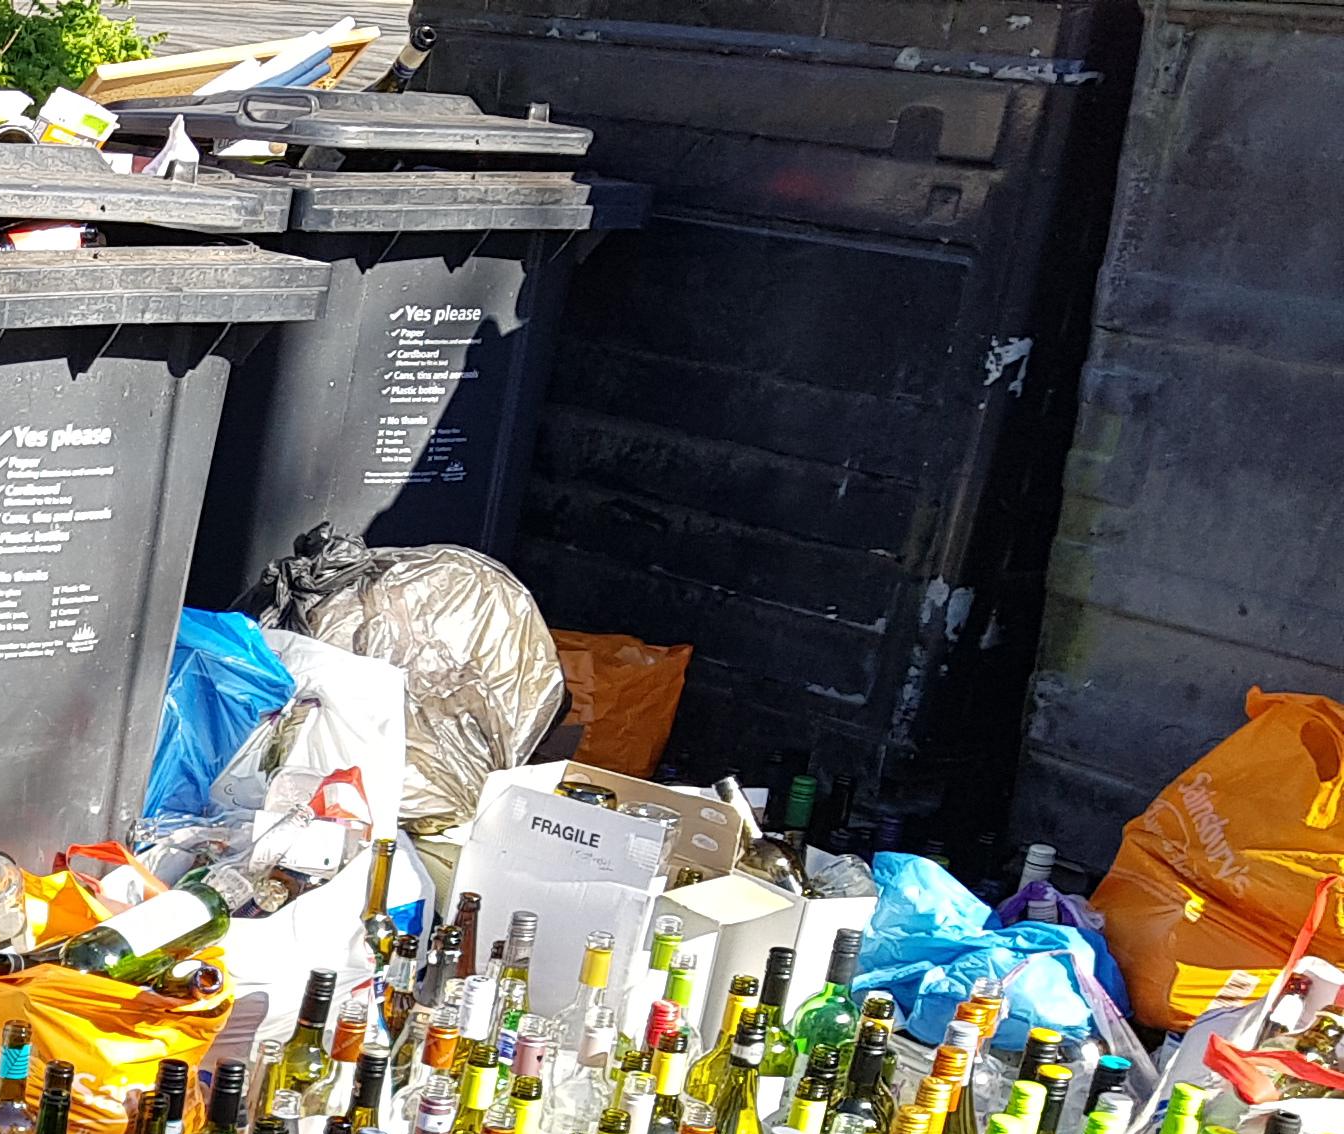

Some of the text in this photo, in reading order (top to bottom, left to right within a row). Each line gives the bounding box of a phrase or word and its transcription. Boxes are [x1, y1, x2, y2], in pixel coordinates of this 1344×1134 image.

[405, 304, 482, 325] Yes please
[13, 423, 112, 452] Yes please
[531, 816, 601, 849] FRAGILE
[1177, 771, 1250, 898] Sainsbury's
